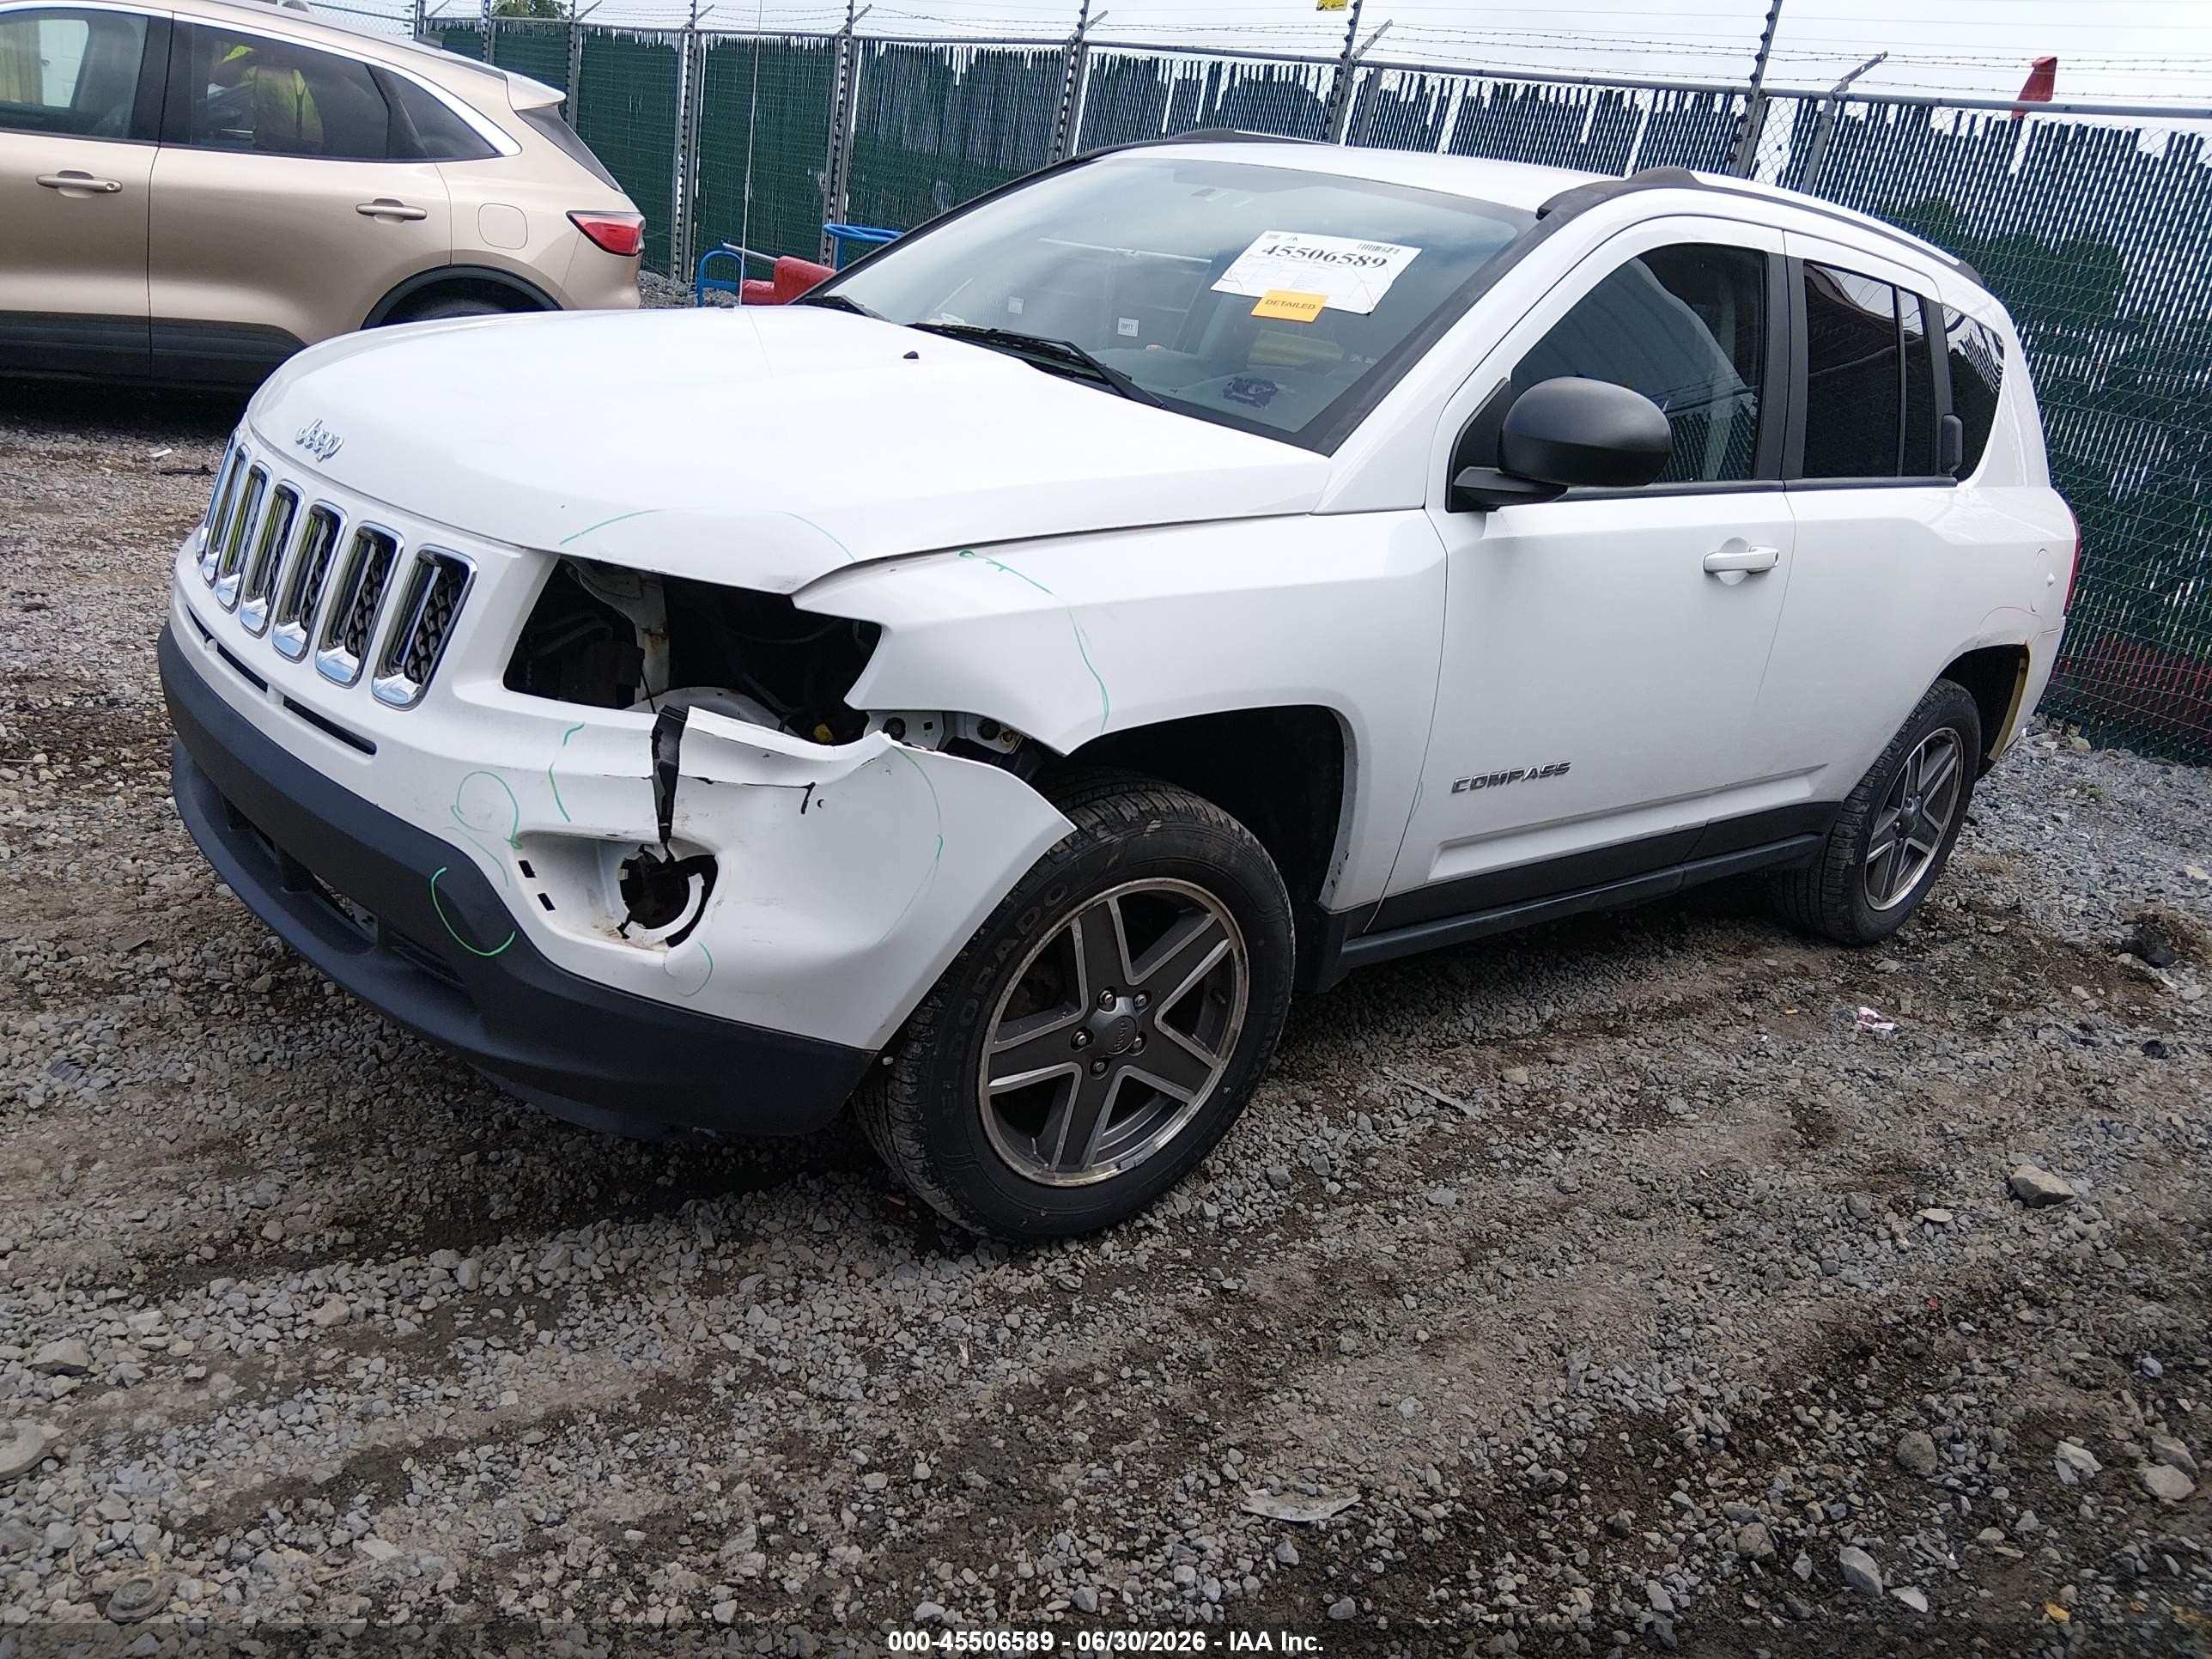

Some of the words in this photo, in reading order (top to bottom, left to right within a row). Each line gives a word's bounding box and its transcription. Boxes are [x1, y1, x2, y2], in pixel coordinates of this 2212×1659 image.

[1261, 244, 1388, 269] 45506589
[1264, 299, 1316, 311] DETAILED
[295, 418, 344, 463] Jeep
[1450, 761, 1571, 794] COMPASS
